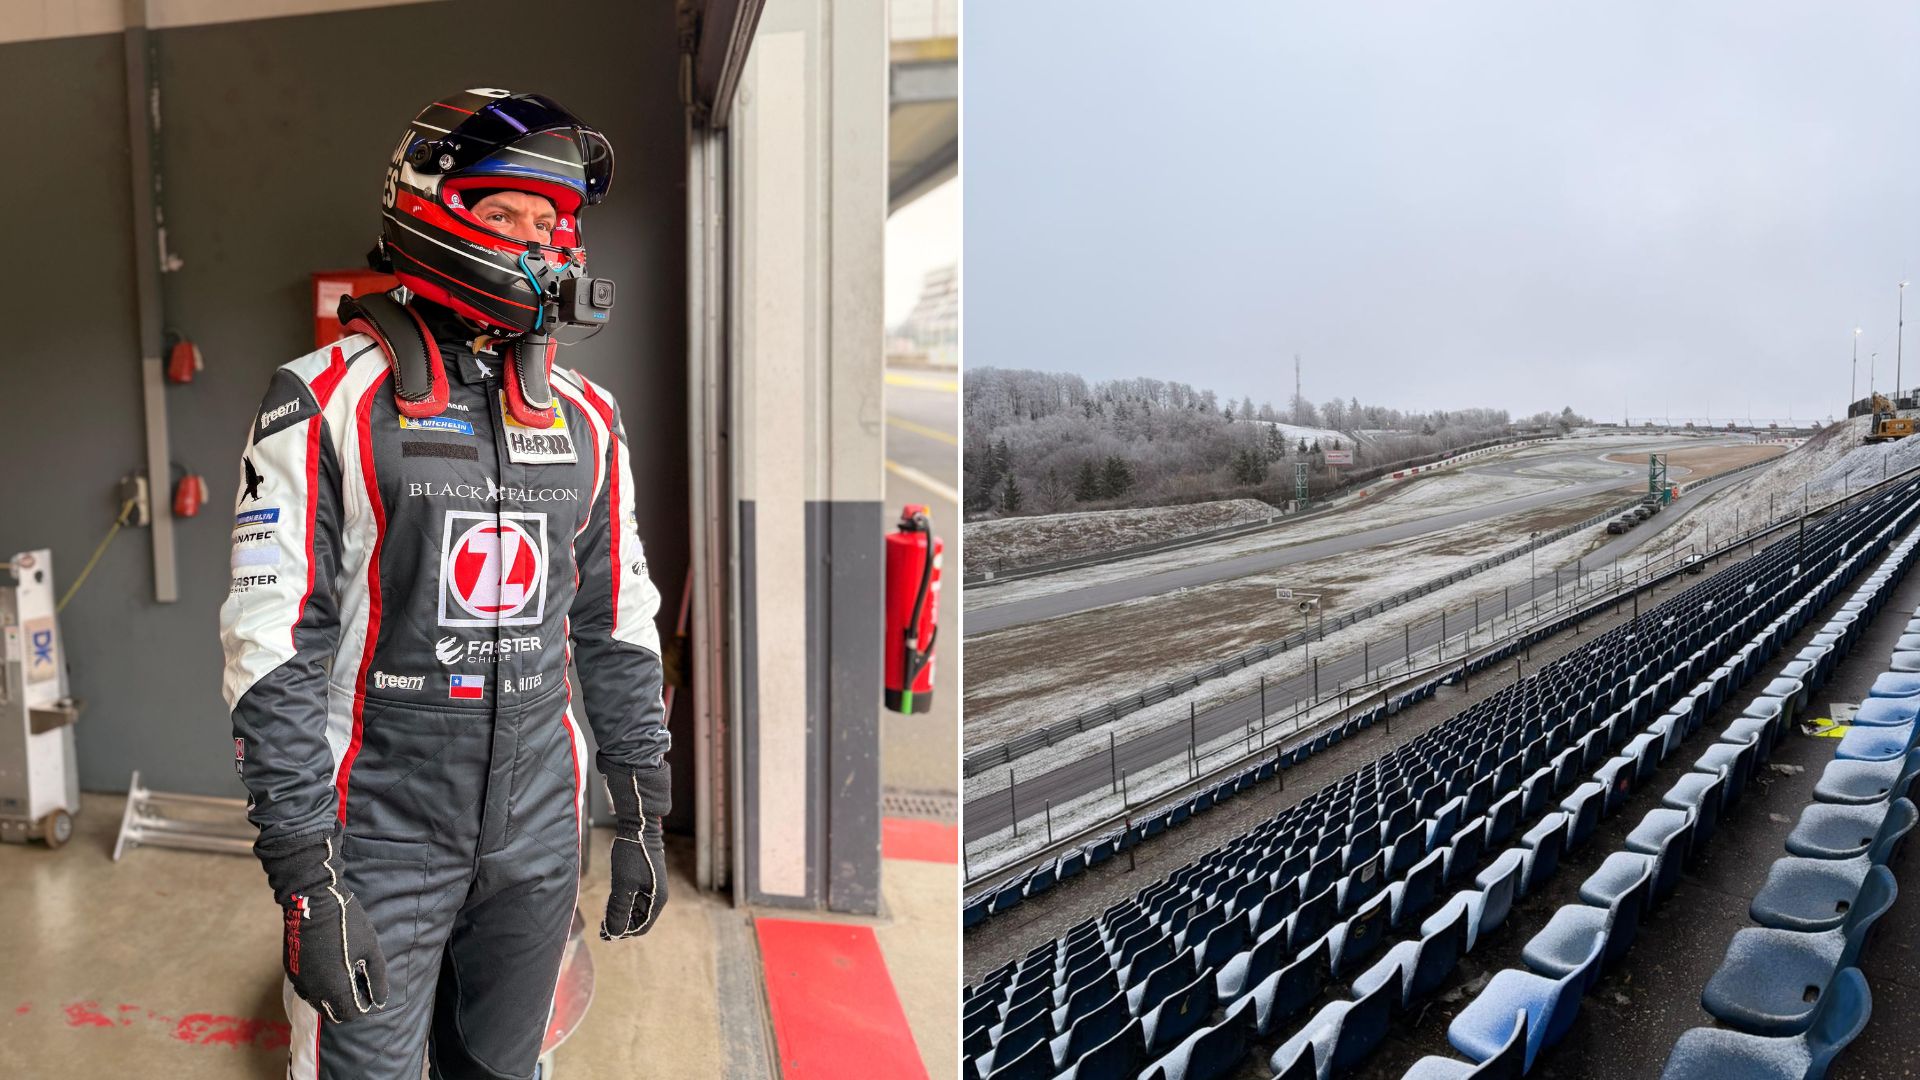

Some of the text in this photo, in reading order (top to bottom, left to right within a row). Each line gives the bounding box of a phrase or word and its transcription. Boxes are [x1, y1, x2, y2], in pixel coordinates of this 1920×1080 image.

[261, 398, 300, 429] freem
[422, 420, 467, 431] MICHELIN
[510, 432, 553, 454] H&R
[408, 482, 579, 502] BLACK FALCON
[467, 636, 543, 655] FASTER
[467, 654, 511, 664] CHILE
[374, 670, 426, 691] freem
[504, 672, 543, 694] B. HITES
